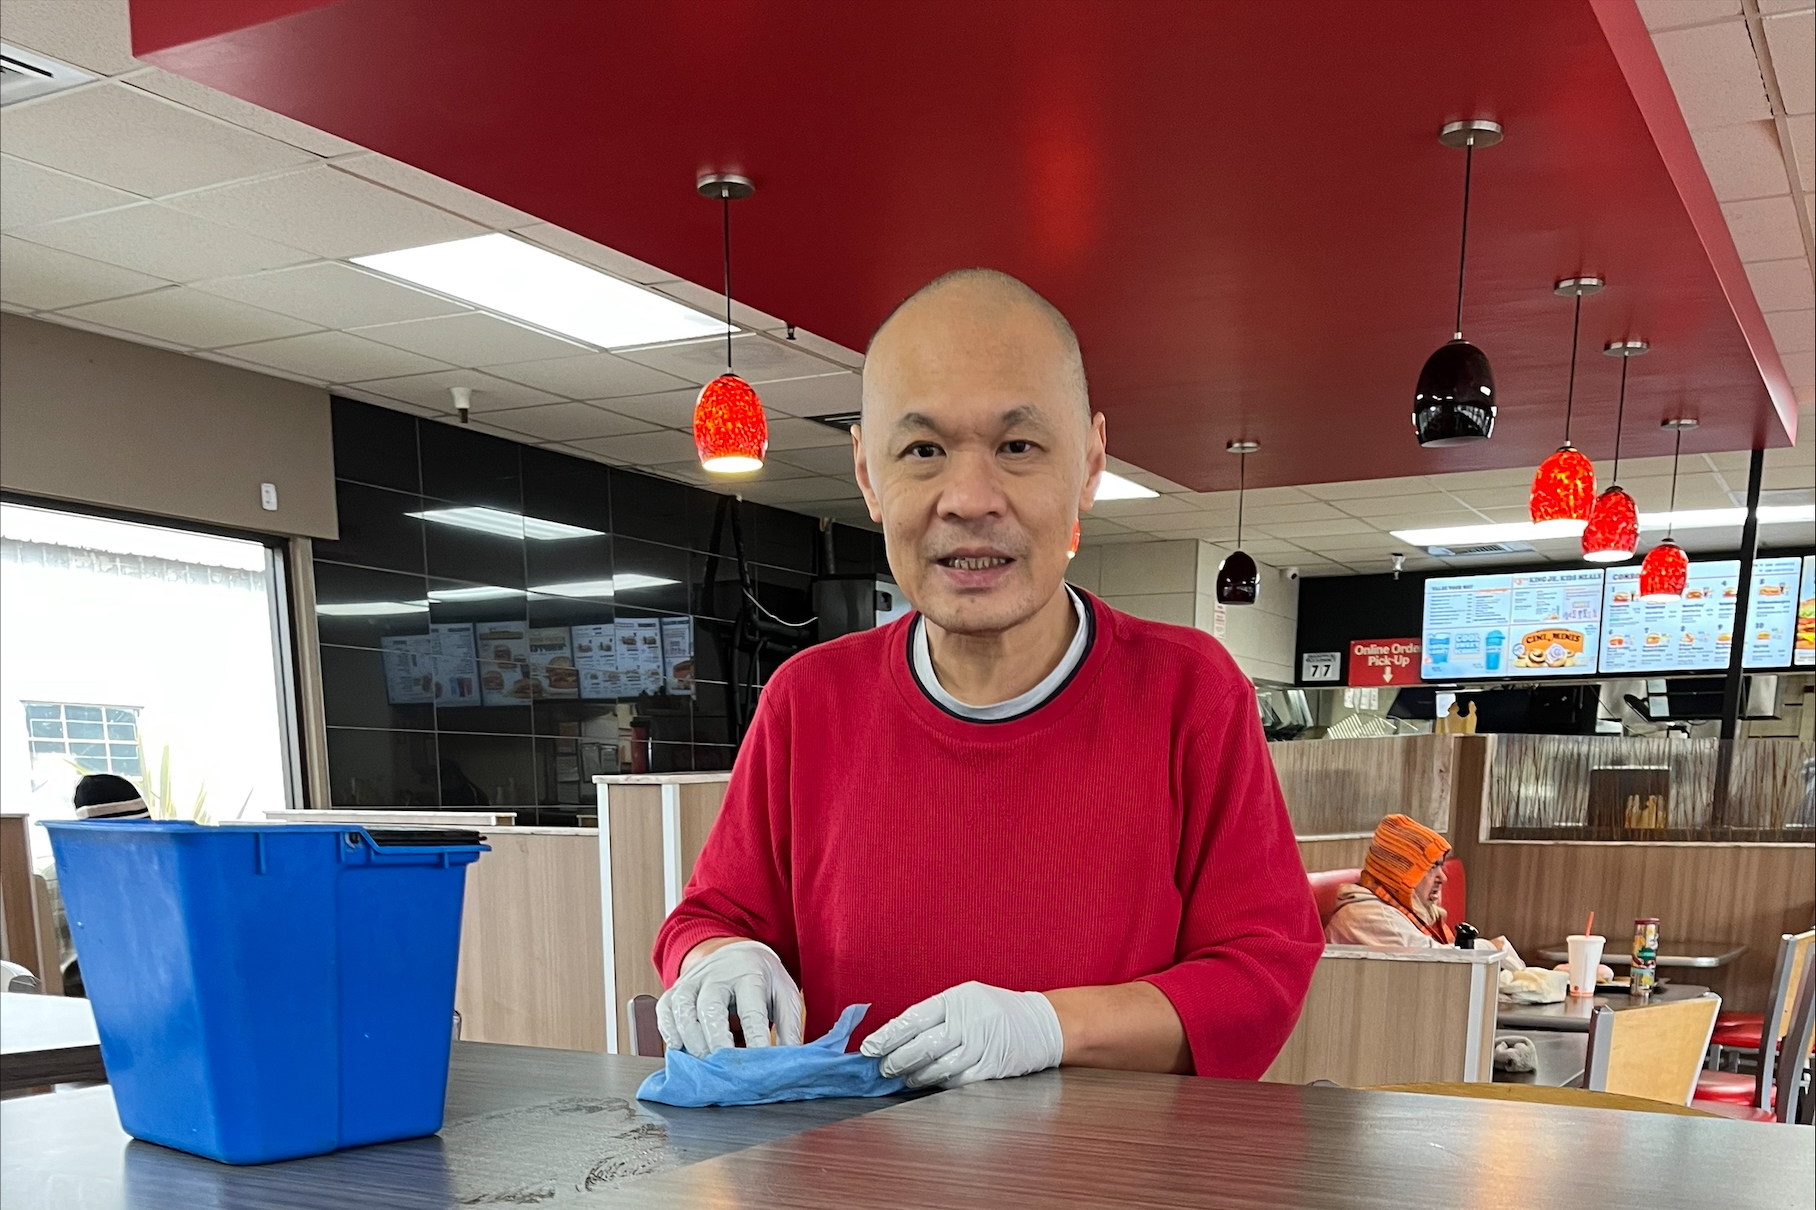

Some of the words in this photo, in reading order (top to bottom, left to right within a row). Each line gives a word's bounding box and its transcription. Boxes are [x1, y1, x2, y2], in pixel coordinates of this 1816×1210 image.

[1354, 644, 1390, 655] Online
[1391, 643, 1422, 654] Orde
[1367, 655, 1411, 667] Pick-Up
